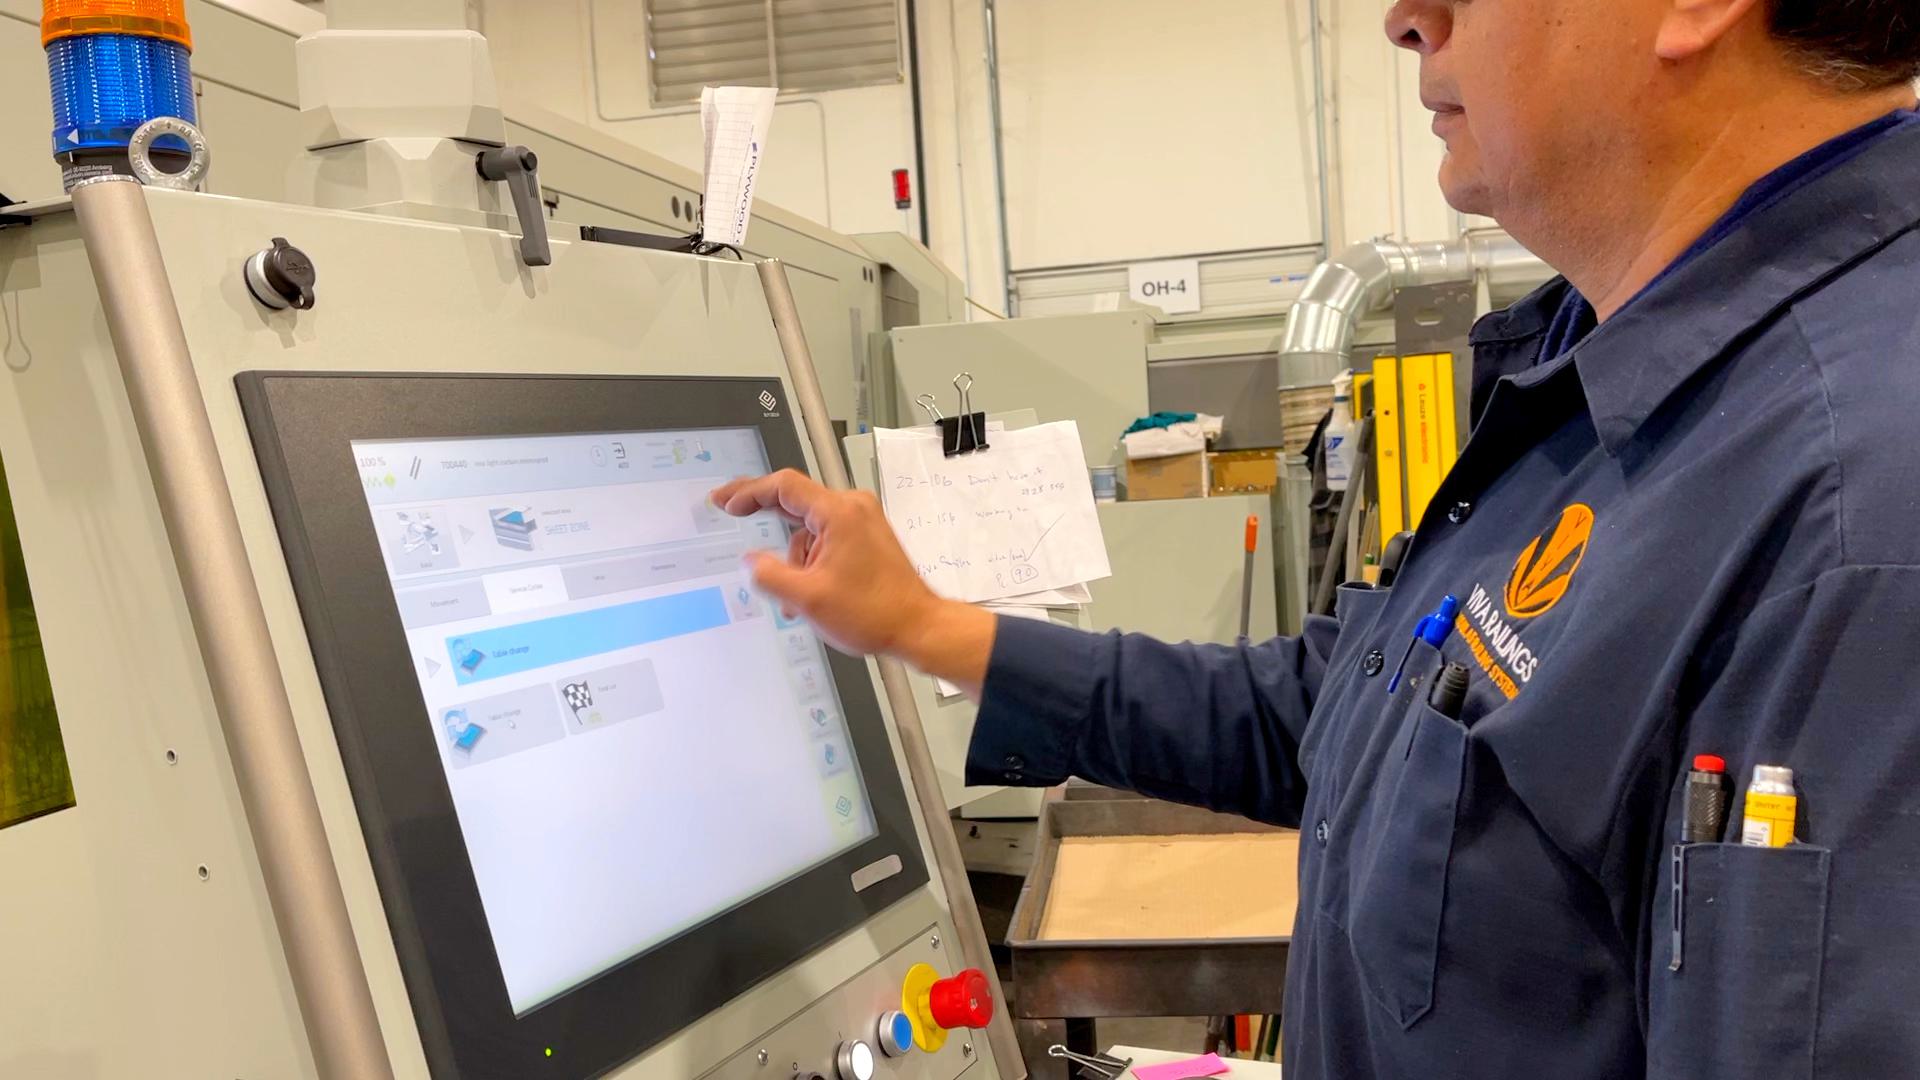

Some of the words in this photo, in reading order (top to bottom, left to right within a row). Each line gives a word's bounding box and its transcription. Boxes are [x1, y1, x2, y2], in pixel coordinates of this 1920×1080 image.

[736, 156, 758, 234] PLYWOOD
[1142, 279, 1187, 297] OH-4
[1466, 583, 1491, 625] VIVA
[1482, 609, 1537, 682] RAILINGS
